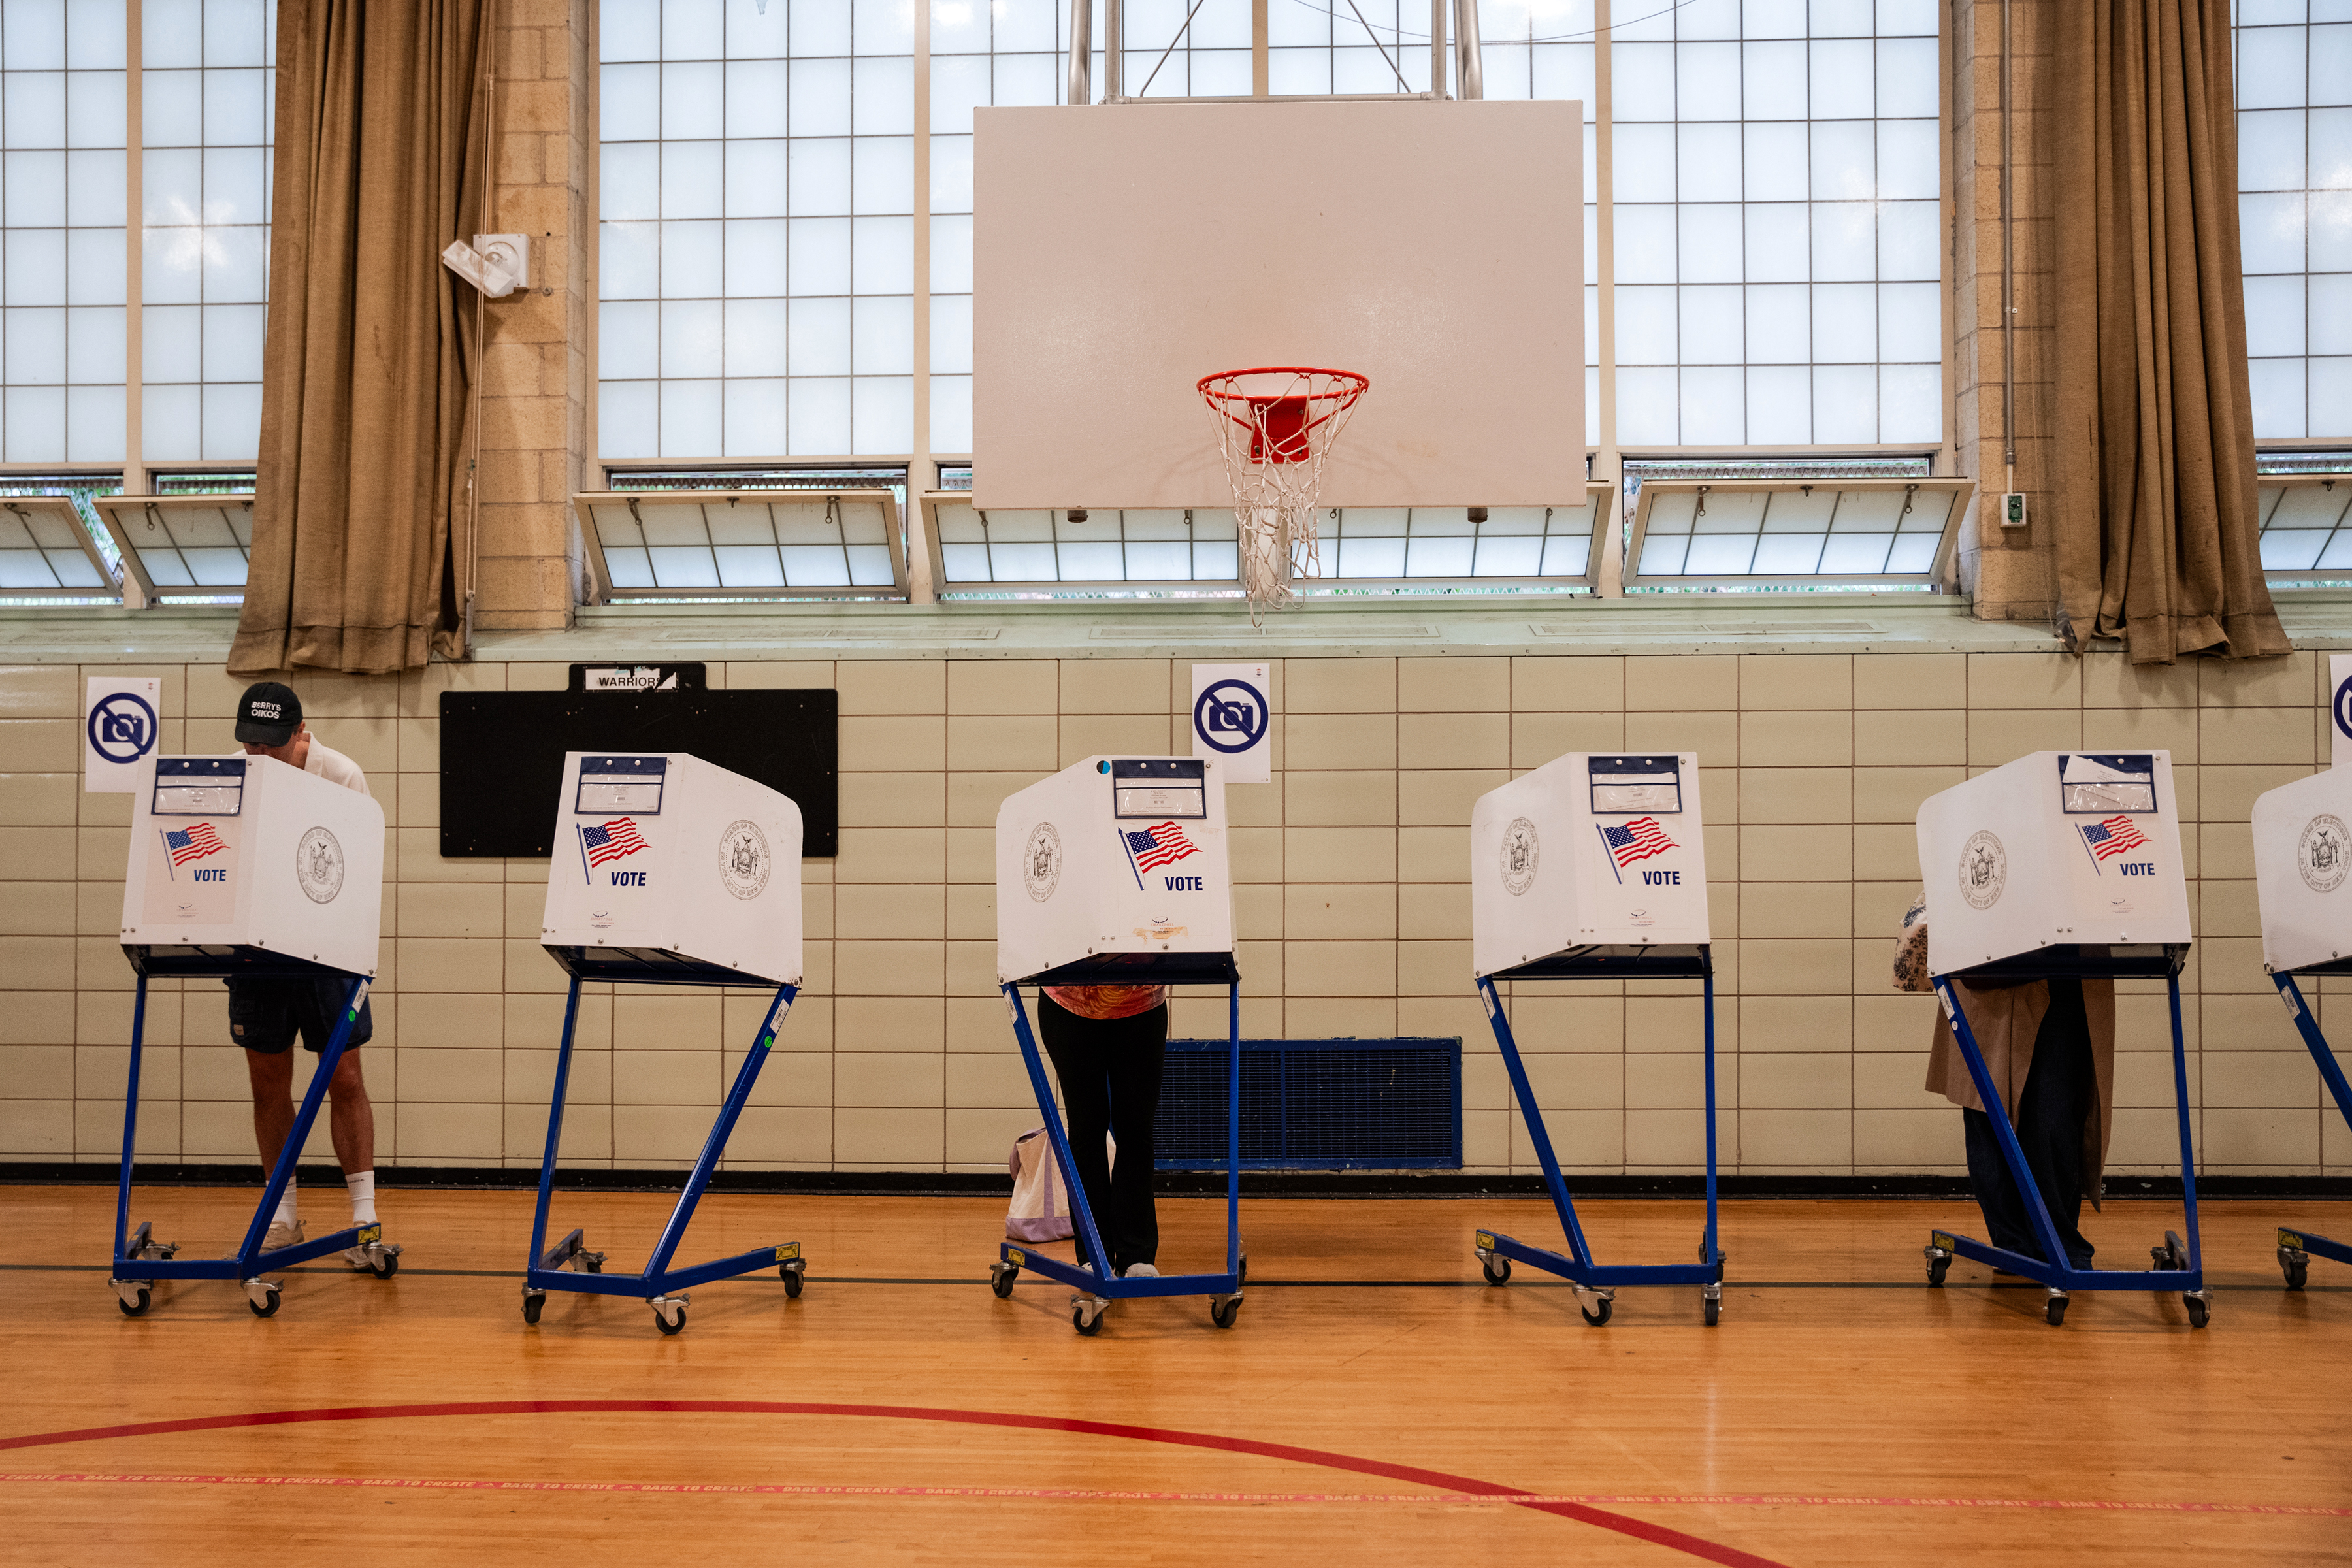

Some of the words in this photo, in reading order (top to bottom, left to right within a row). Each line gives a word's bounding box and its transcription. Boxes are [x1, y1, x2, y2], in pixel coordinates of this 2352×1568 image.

[251, 708, 280, 719] OIKOS
[194, 869, 227, 882] VOTE
[2119, 863, 2155, 876] VOTE
[611, 872, 647, 886] VOTE
[1164, 876, 1203, 891] VOTE
[1642, 870, 1680, 885] VOTE
